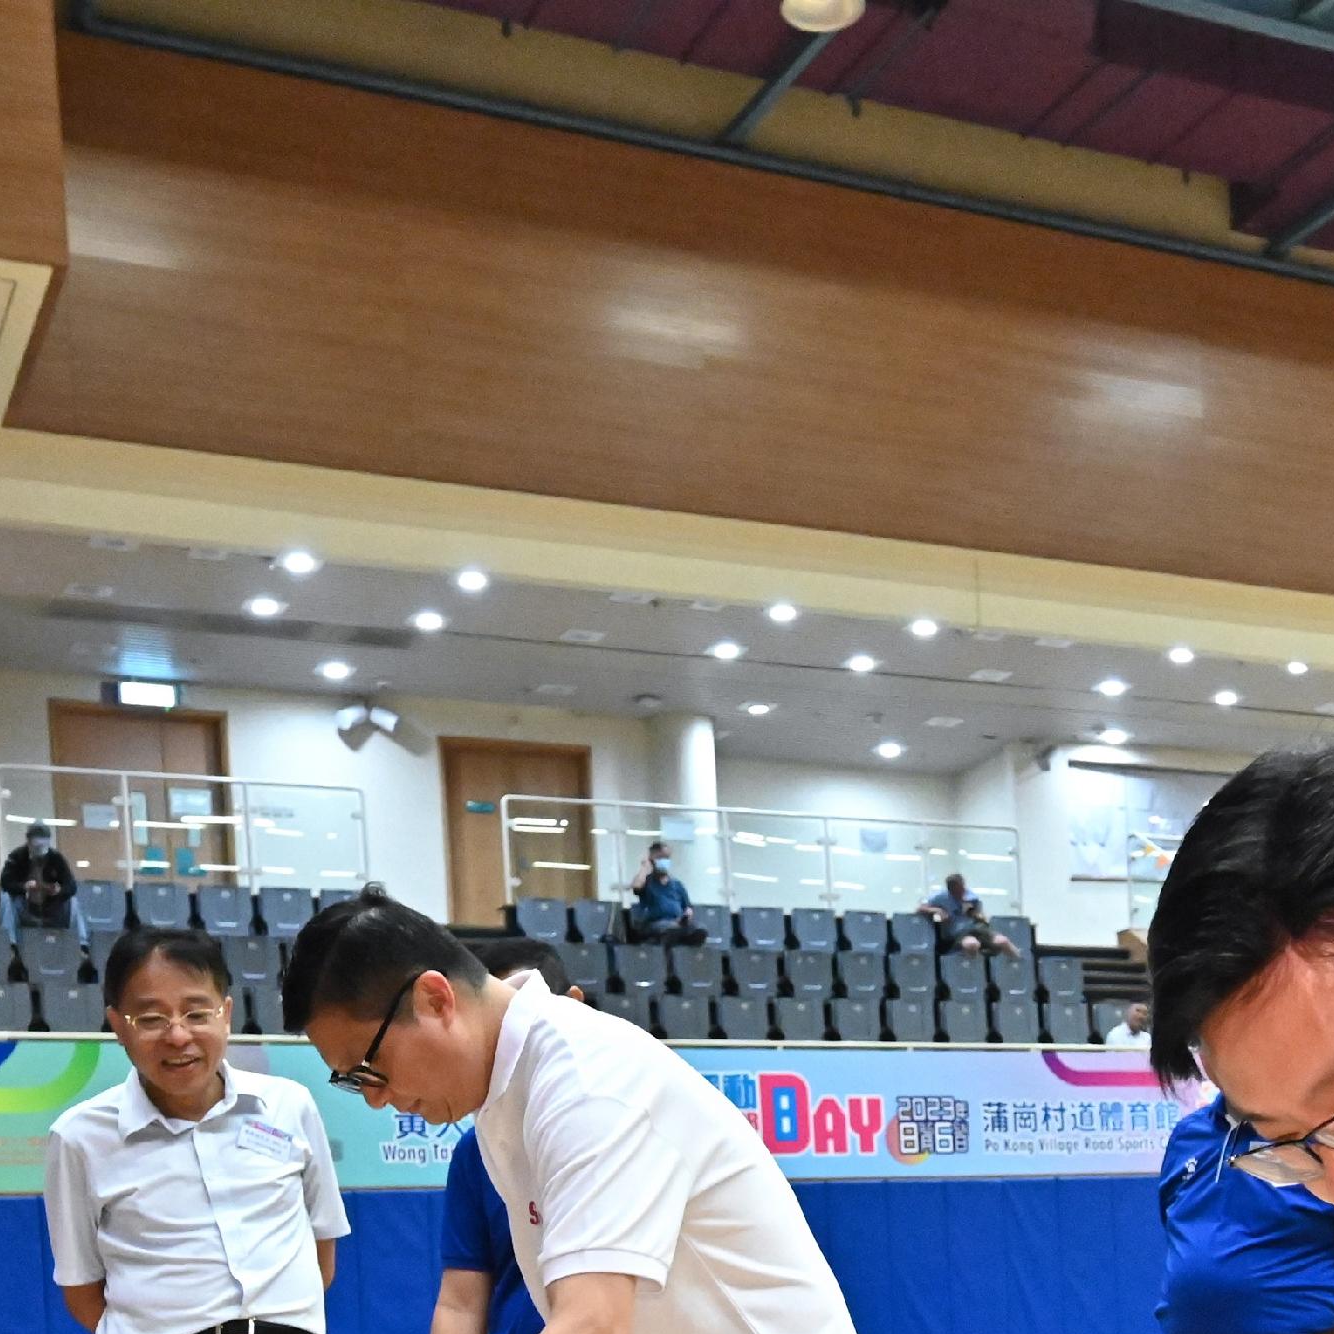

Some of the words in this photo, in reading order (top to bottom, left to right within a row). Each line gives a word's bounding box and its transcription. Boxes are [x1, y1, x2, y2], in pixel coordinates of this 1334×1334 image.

[383, 1145, 427, 1164] Wong
[984, 1139, 1000, 1152] Po
[1004, 1139, 1035, 1154] Kong
[1039, 1138, 1080, 1154] Village
[1084, 1137, 1114, 1150] Road
[1118, 1137, 1155, 1153] Sports
